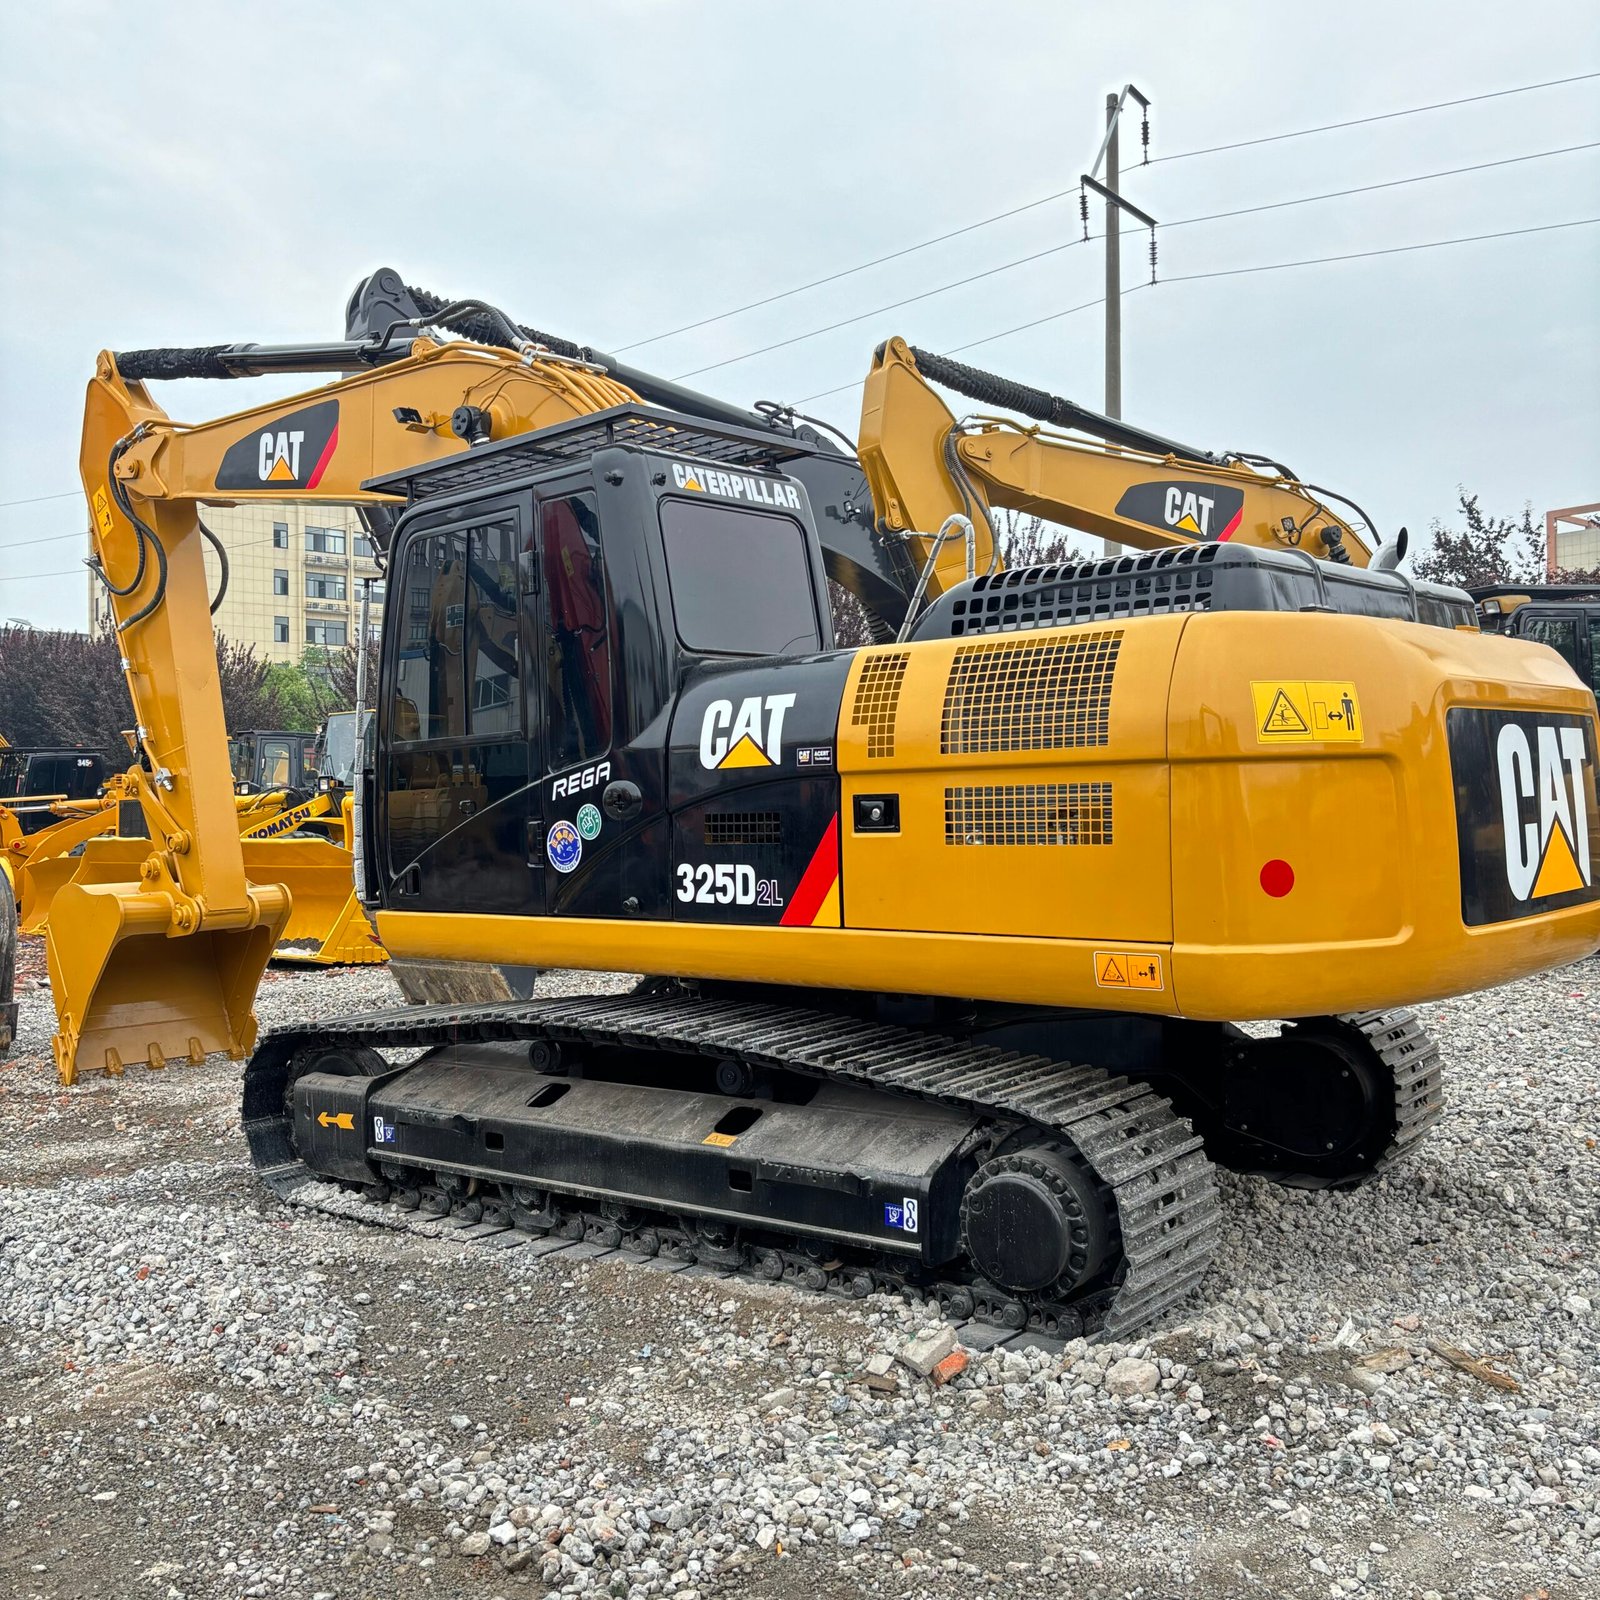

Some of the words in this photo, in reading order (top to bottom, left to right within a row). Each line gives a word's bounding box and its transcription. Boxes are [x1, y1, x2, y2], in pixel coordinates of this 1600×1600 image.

[258, 430, 304, 481] CAT
[672, 463, 801, 509] CATERPILLAR
[1164, 486, 1214, 536] CAT
[700, 693, 796, 769] CAT
[552, 761, 610, 801] REGA
[1497, 723, 1591, 901] CAT
